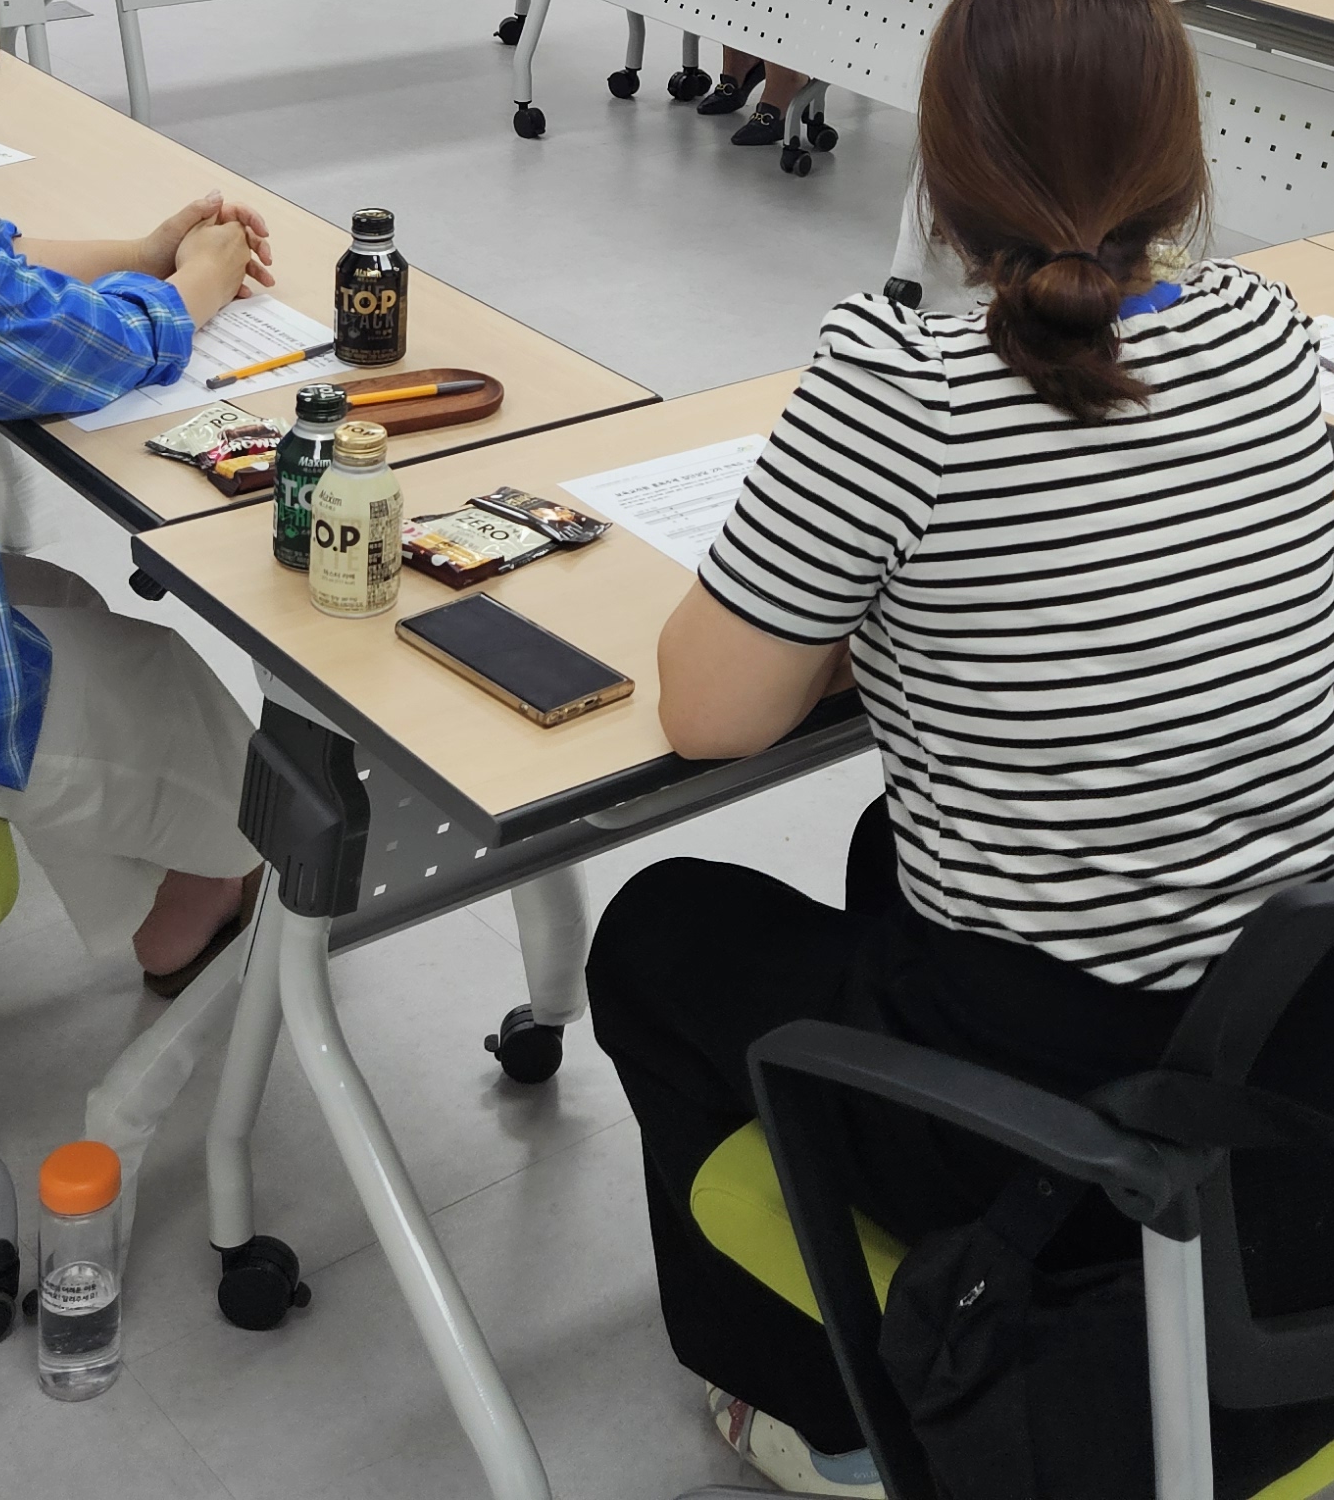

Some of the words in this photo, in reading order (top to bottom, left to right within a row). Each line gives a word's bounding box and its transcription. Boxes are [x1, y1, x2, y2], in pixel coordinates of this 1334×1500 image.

[340, 286, 397, 316] T.O.P
[319, 489, 343, 507] Maxim
[455, 515, 509, 541] ZERO
